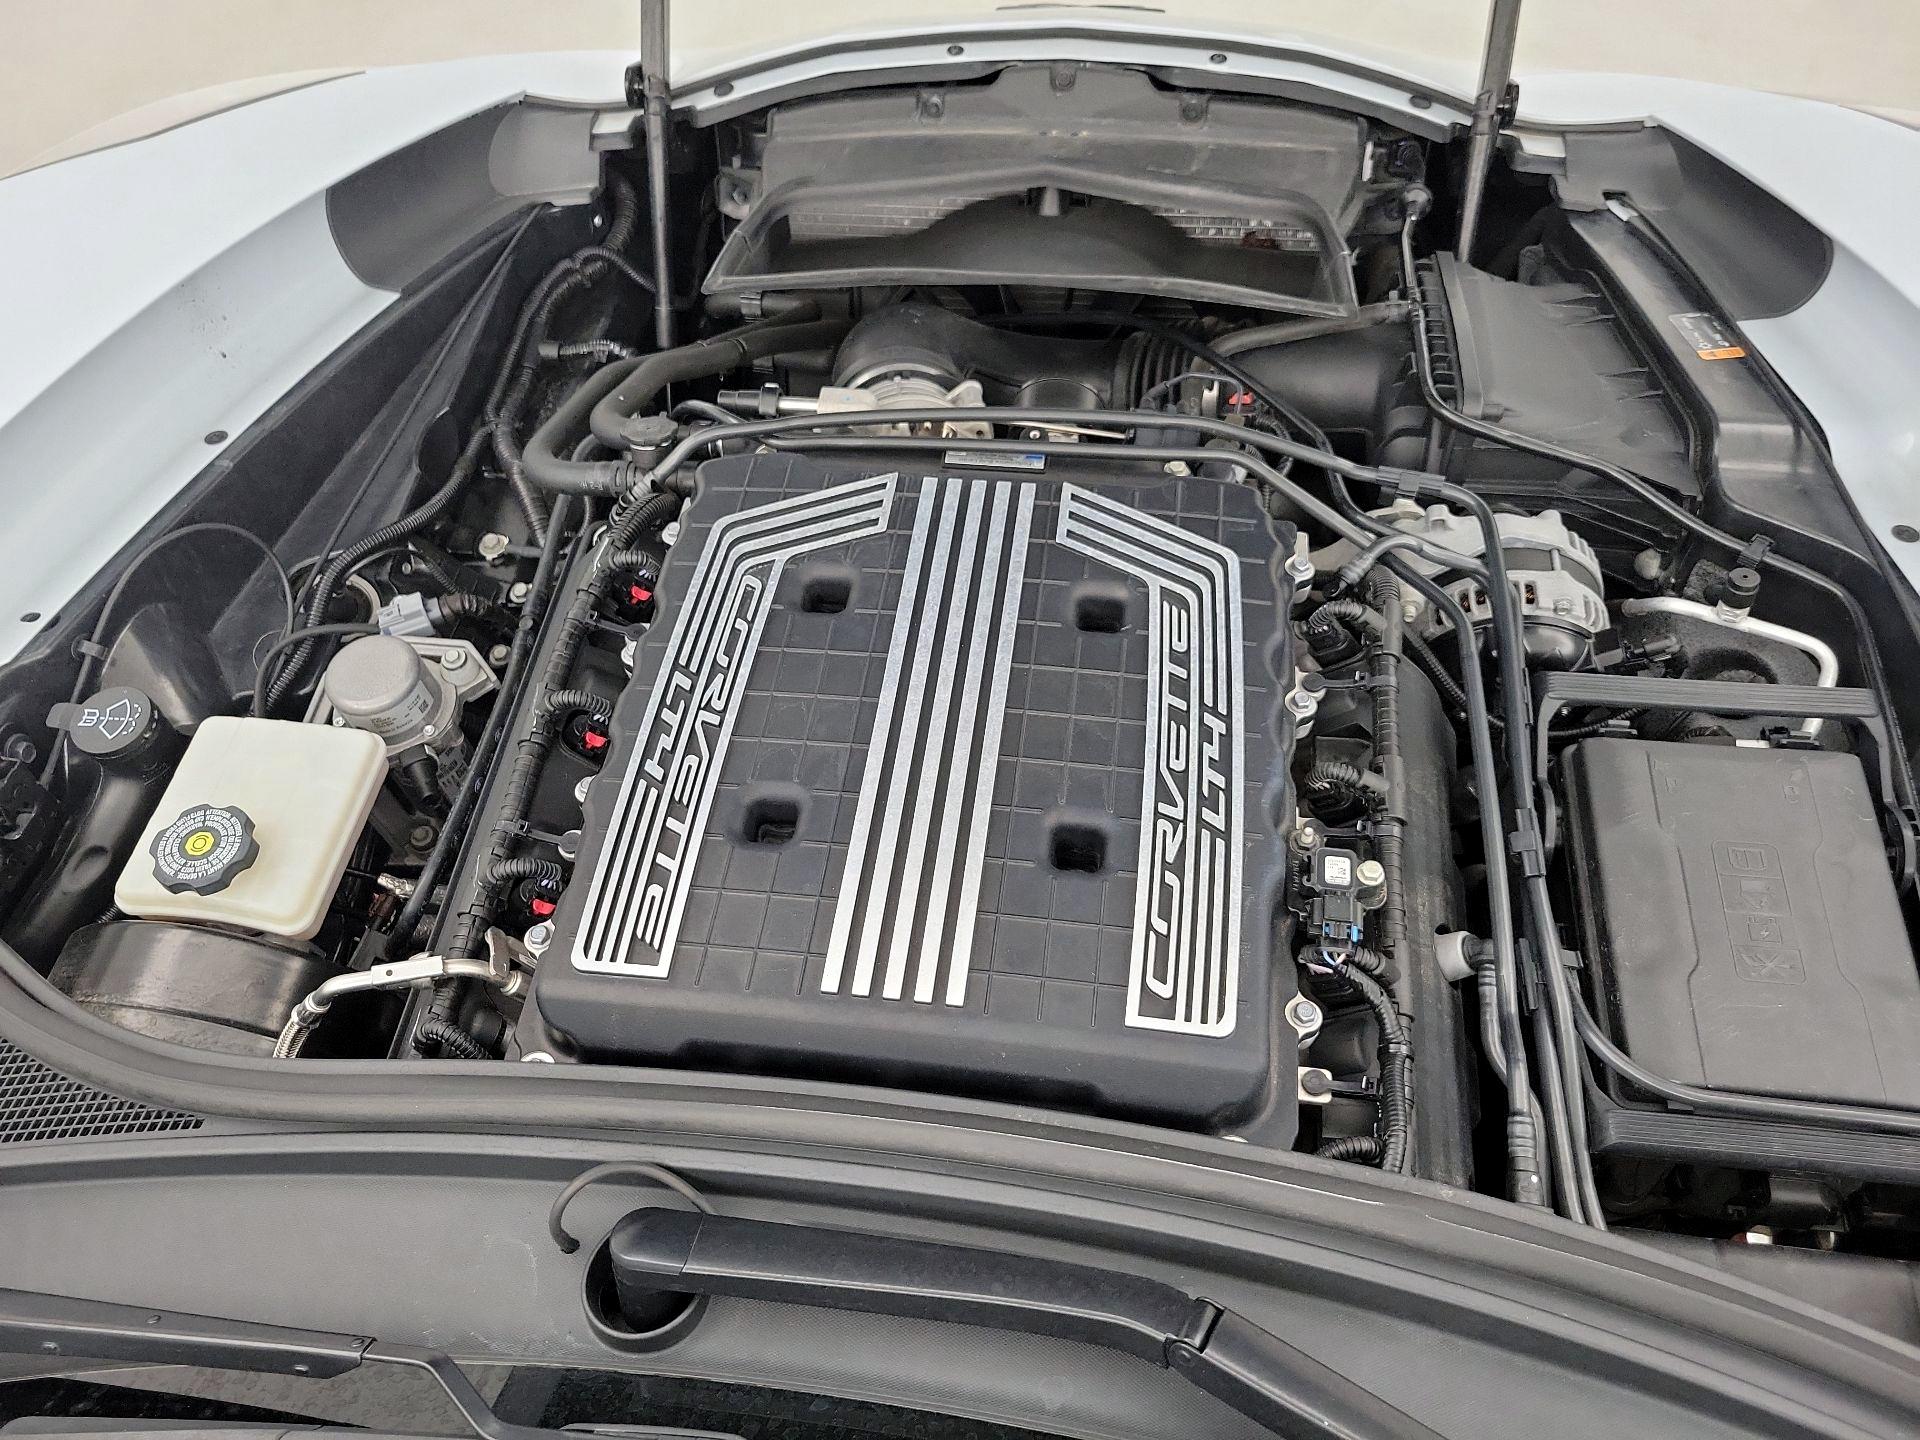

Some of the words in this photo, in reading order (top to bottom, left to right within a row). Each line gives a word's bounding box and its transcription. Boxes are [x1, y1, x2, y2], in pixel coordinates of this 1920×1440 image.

[636, 574, 763, 952] CORVETTE
[644, 670, 693, 782] LT4
[1145, 599, 1189, 1000] CORVETTE
[1201, 711, 1228, 832] LT4
